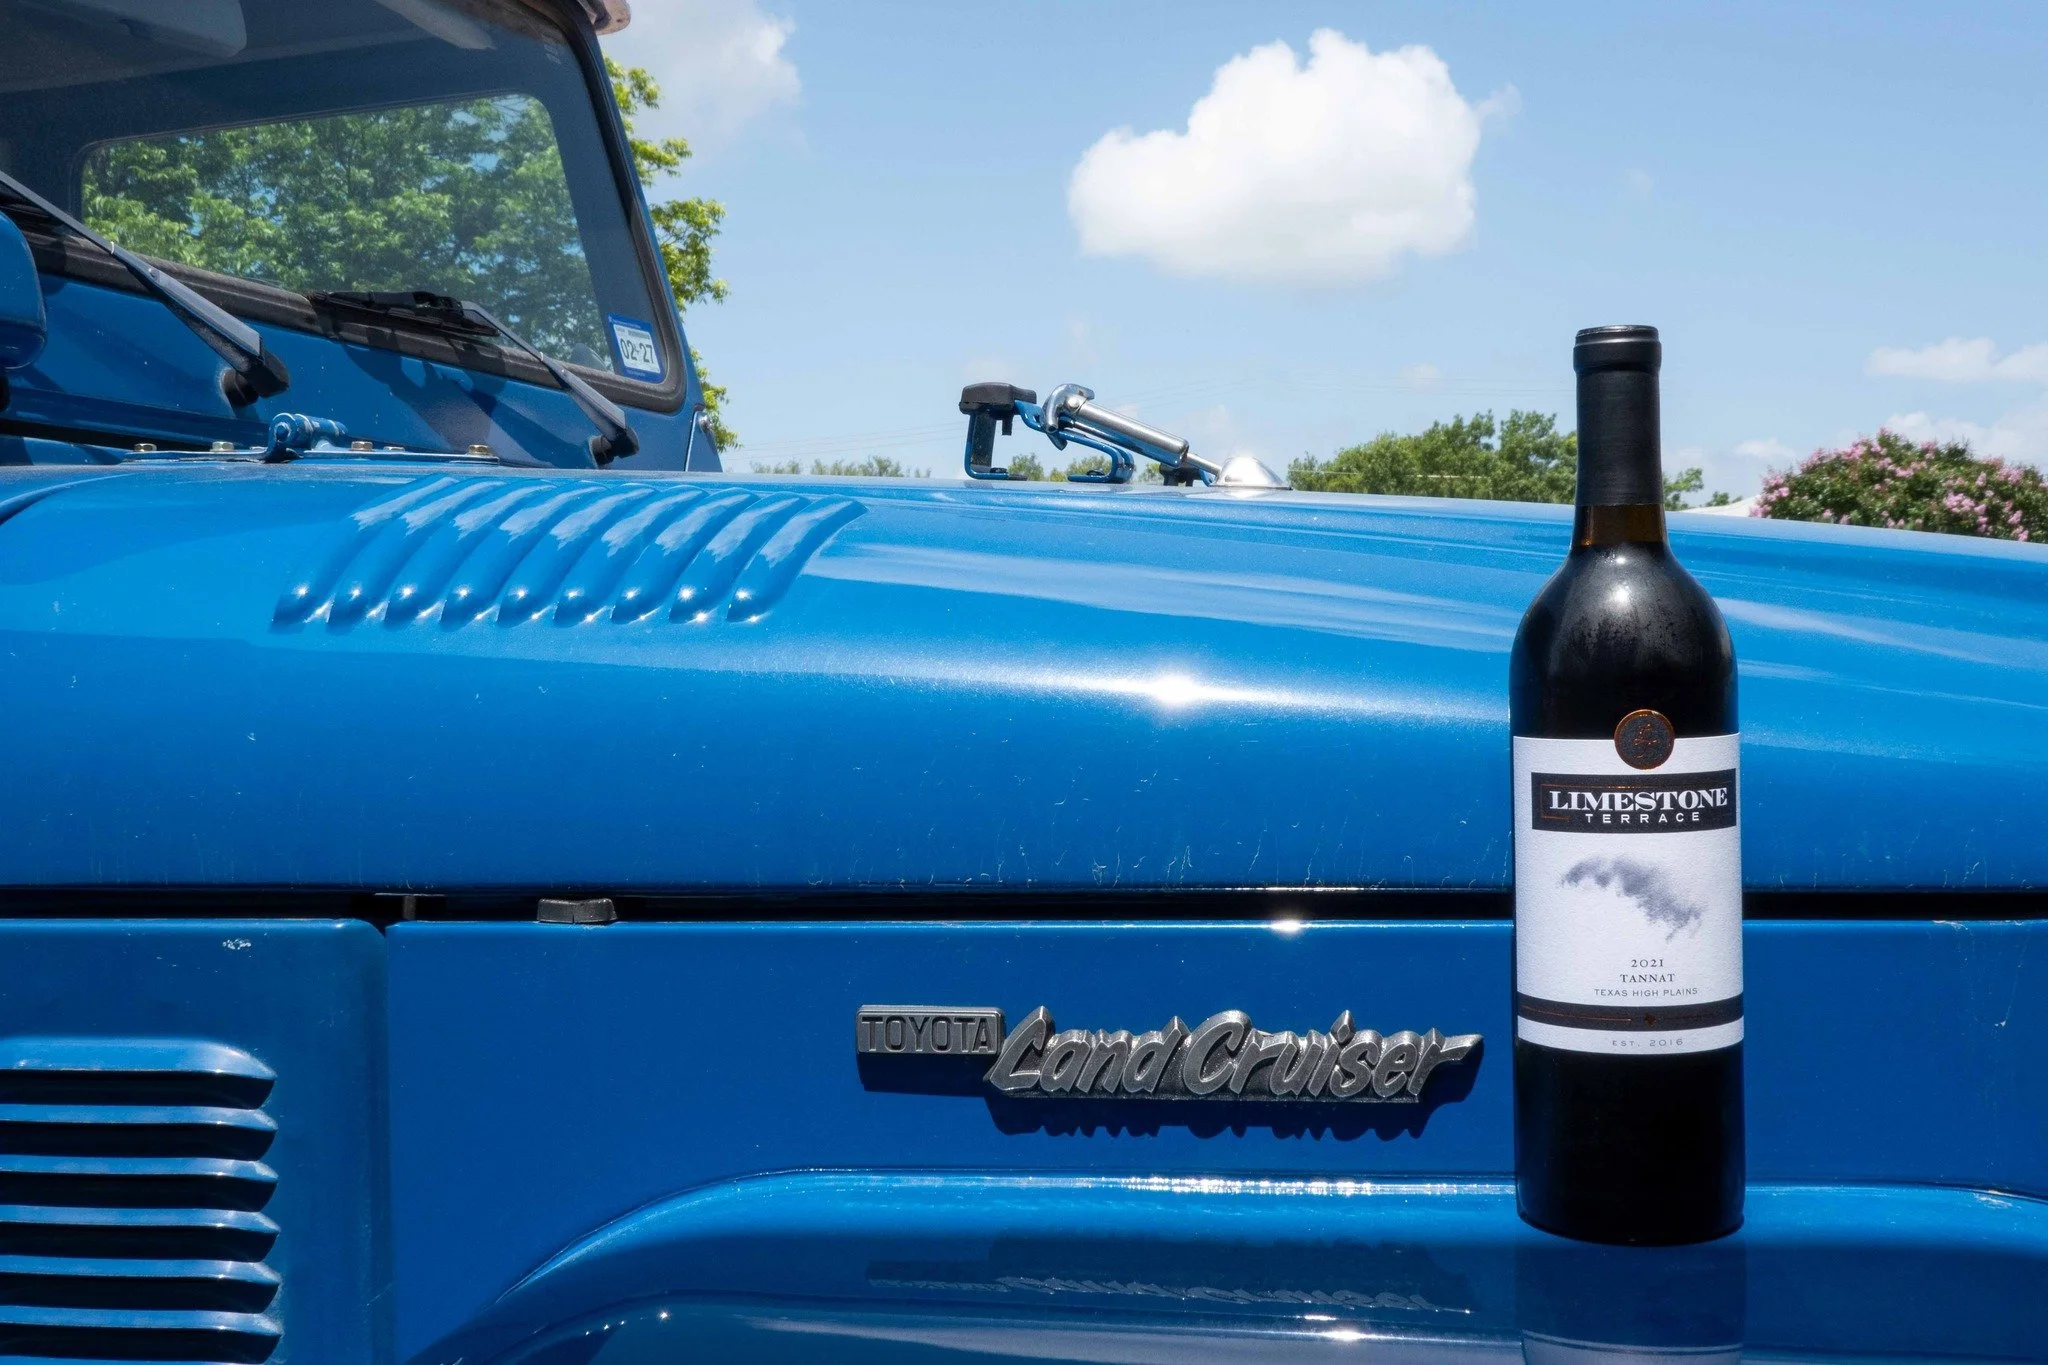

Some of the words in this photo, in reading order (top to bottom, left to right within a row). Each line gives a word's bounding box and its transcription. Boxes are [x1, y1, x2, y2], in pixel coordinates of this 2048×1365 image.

[1549, 787, 1728, 811] LIMESTONE
[1585, 811, 1700, 824] TERRACE
[1631, 959, 1664, 968] 2021
[1619, 973, 1675, 983] TANNAT
[1594, 988, 1628, 997] TEXAS
[1632, 989, 1659, 997] HIGH
[1663, 987, 1698, 997] PLAINS
[1649, 1038, 1684, 1047] 2016
[861, 1015, 996, 1053] TOYOTA
[986, 1005, 1189, 1098] Land
[1188, 1009, 1485, 1102] Cruiser
